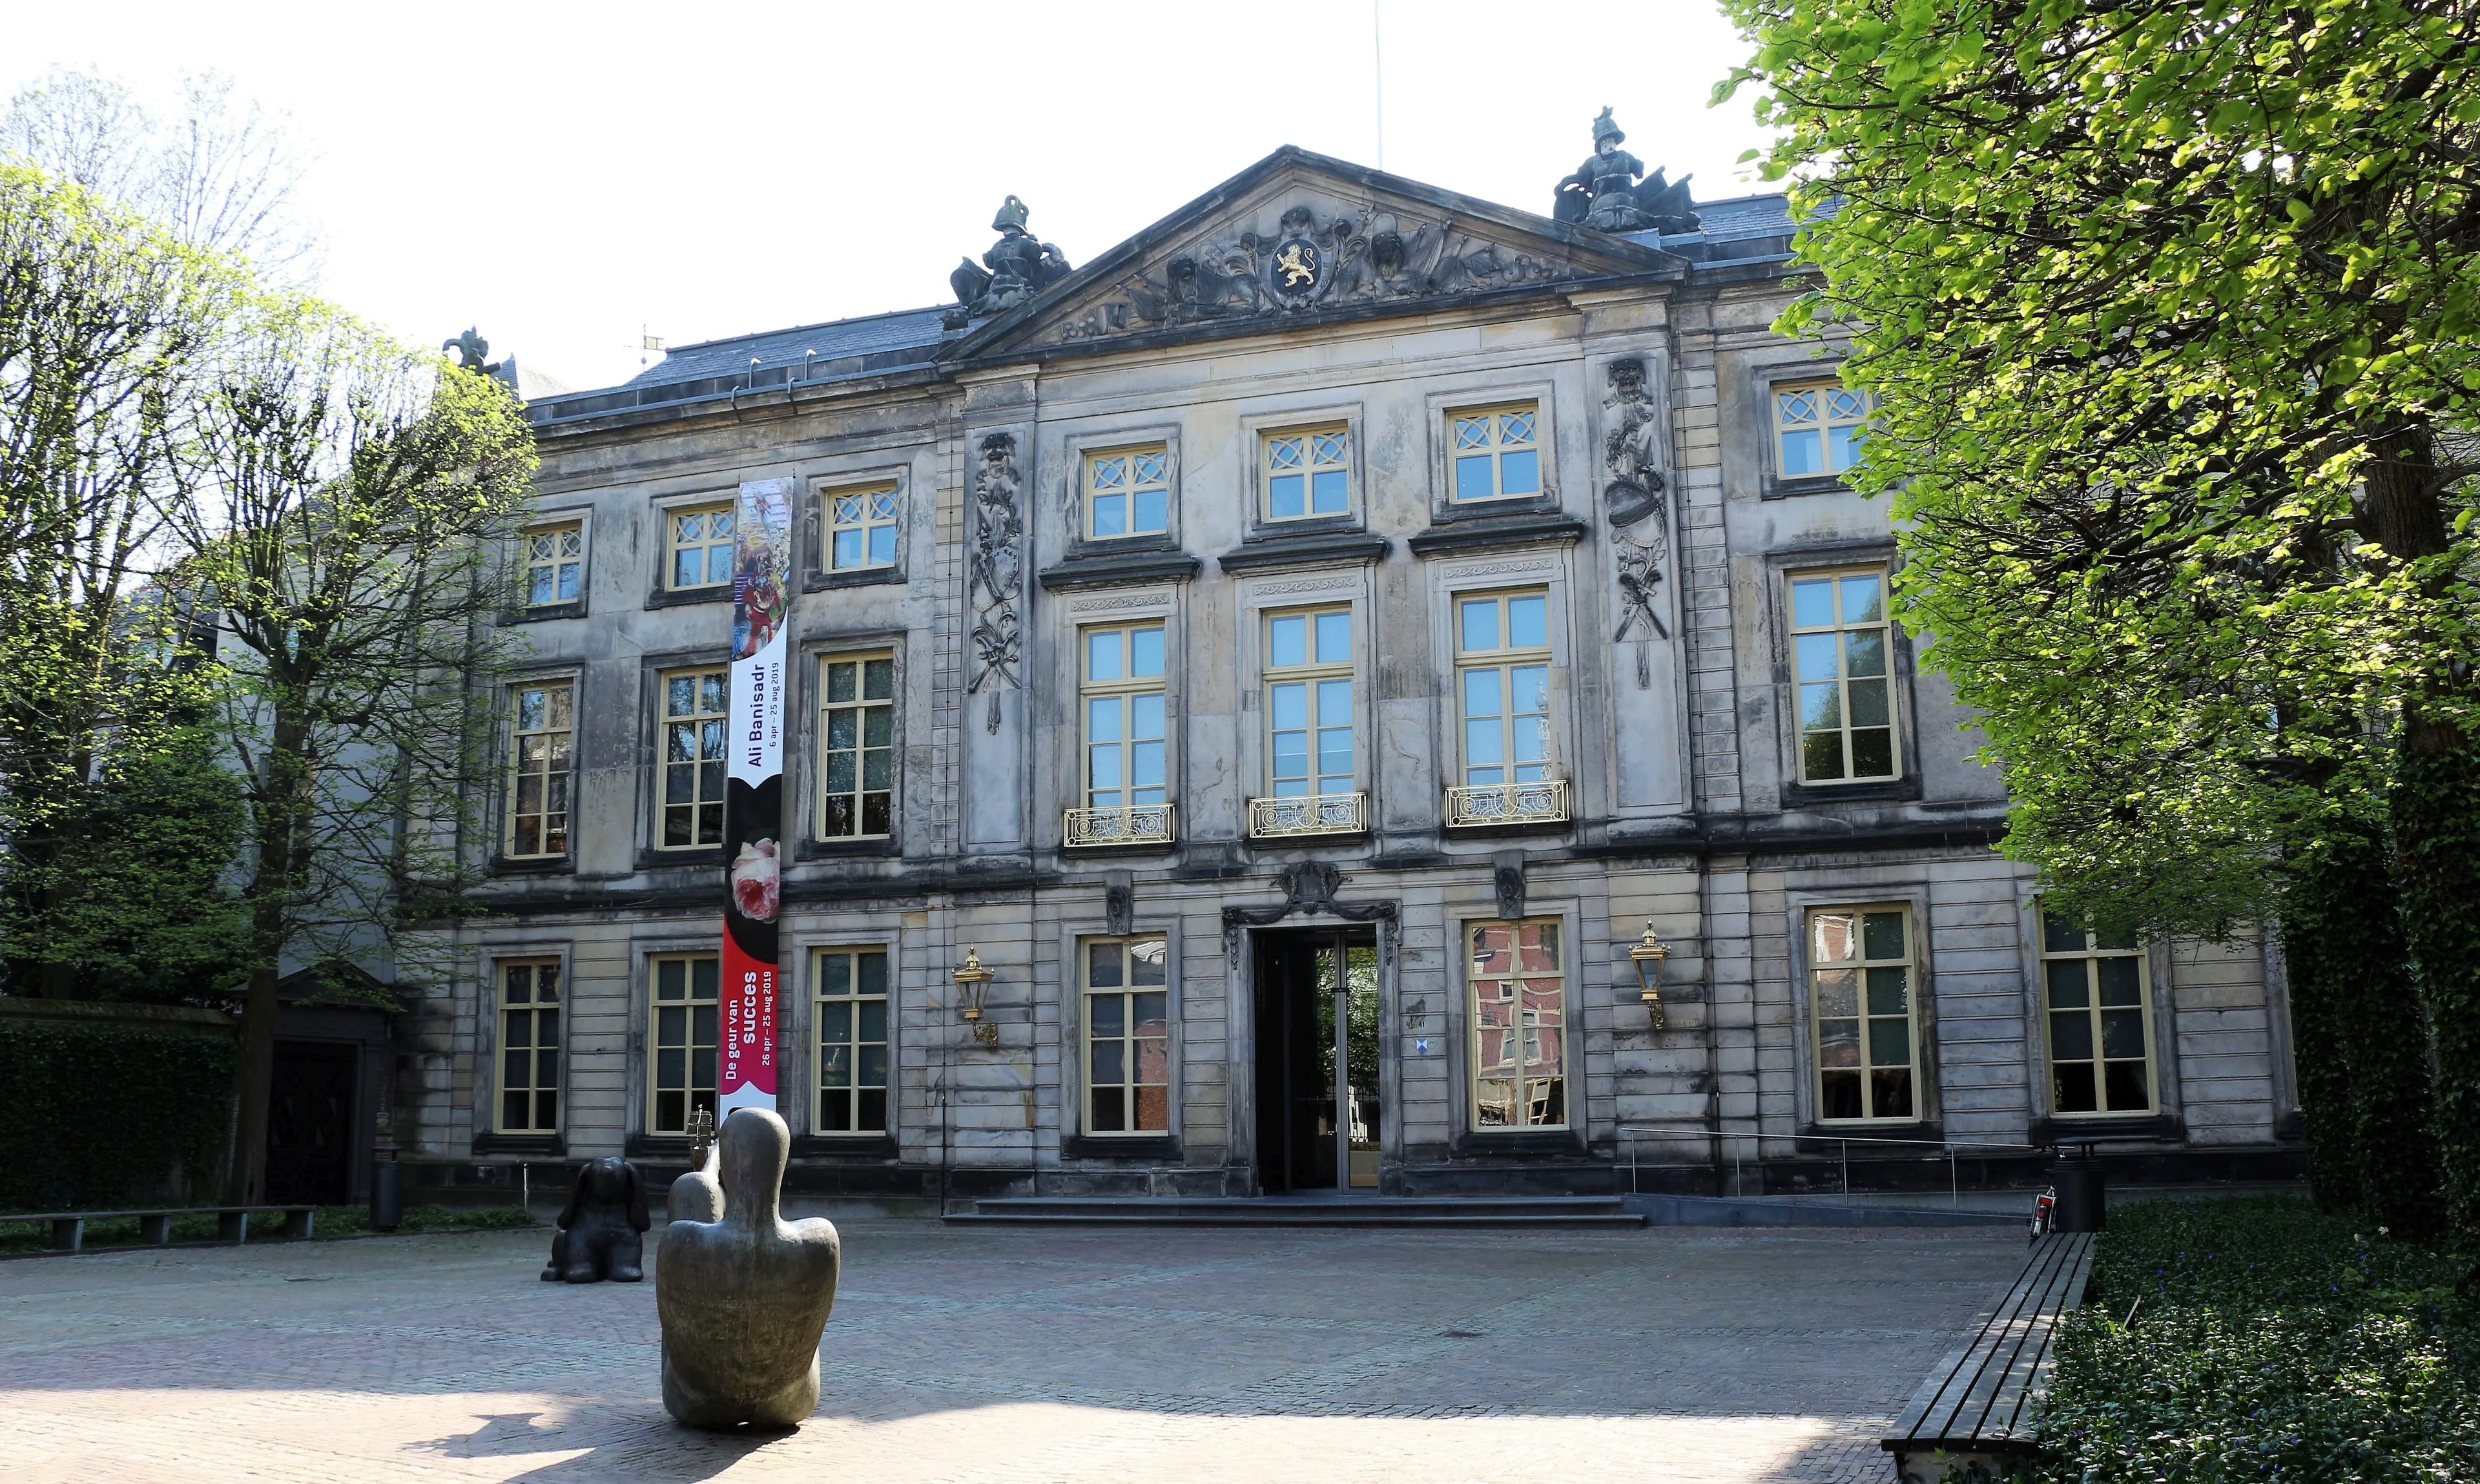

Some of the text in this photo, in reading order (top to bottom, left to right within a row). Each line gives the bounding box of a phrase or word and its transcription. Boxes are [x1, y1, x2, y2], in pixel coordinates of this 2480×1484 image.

[772, 686, 780, 701] aug
[748, 664, 765, 767] Ali Banisadr
[770, 705, 778, 715] 25
[763, 971, 771, 994] 2019
[743, 972, 757, 1044] succes
[764, 996, 773, 1013] aug
[762, 1015, 770, 1027] 25
[725, 1000, 740, 1080] De geur van
[763, 1036, 772, 1052] apr
[762, 1054, 770, 1066] 26
